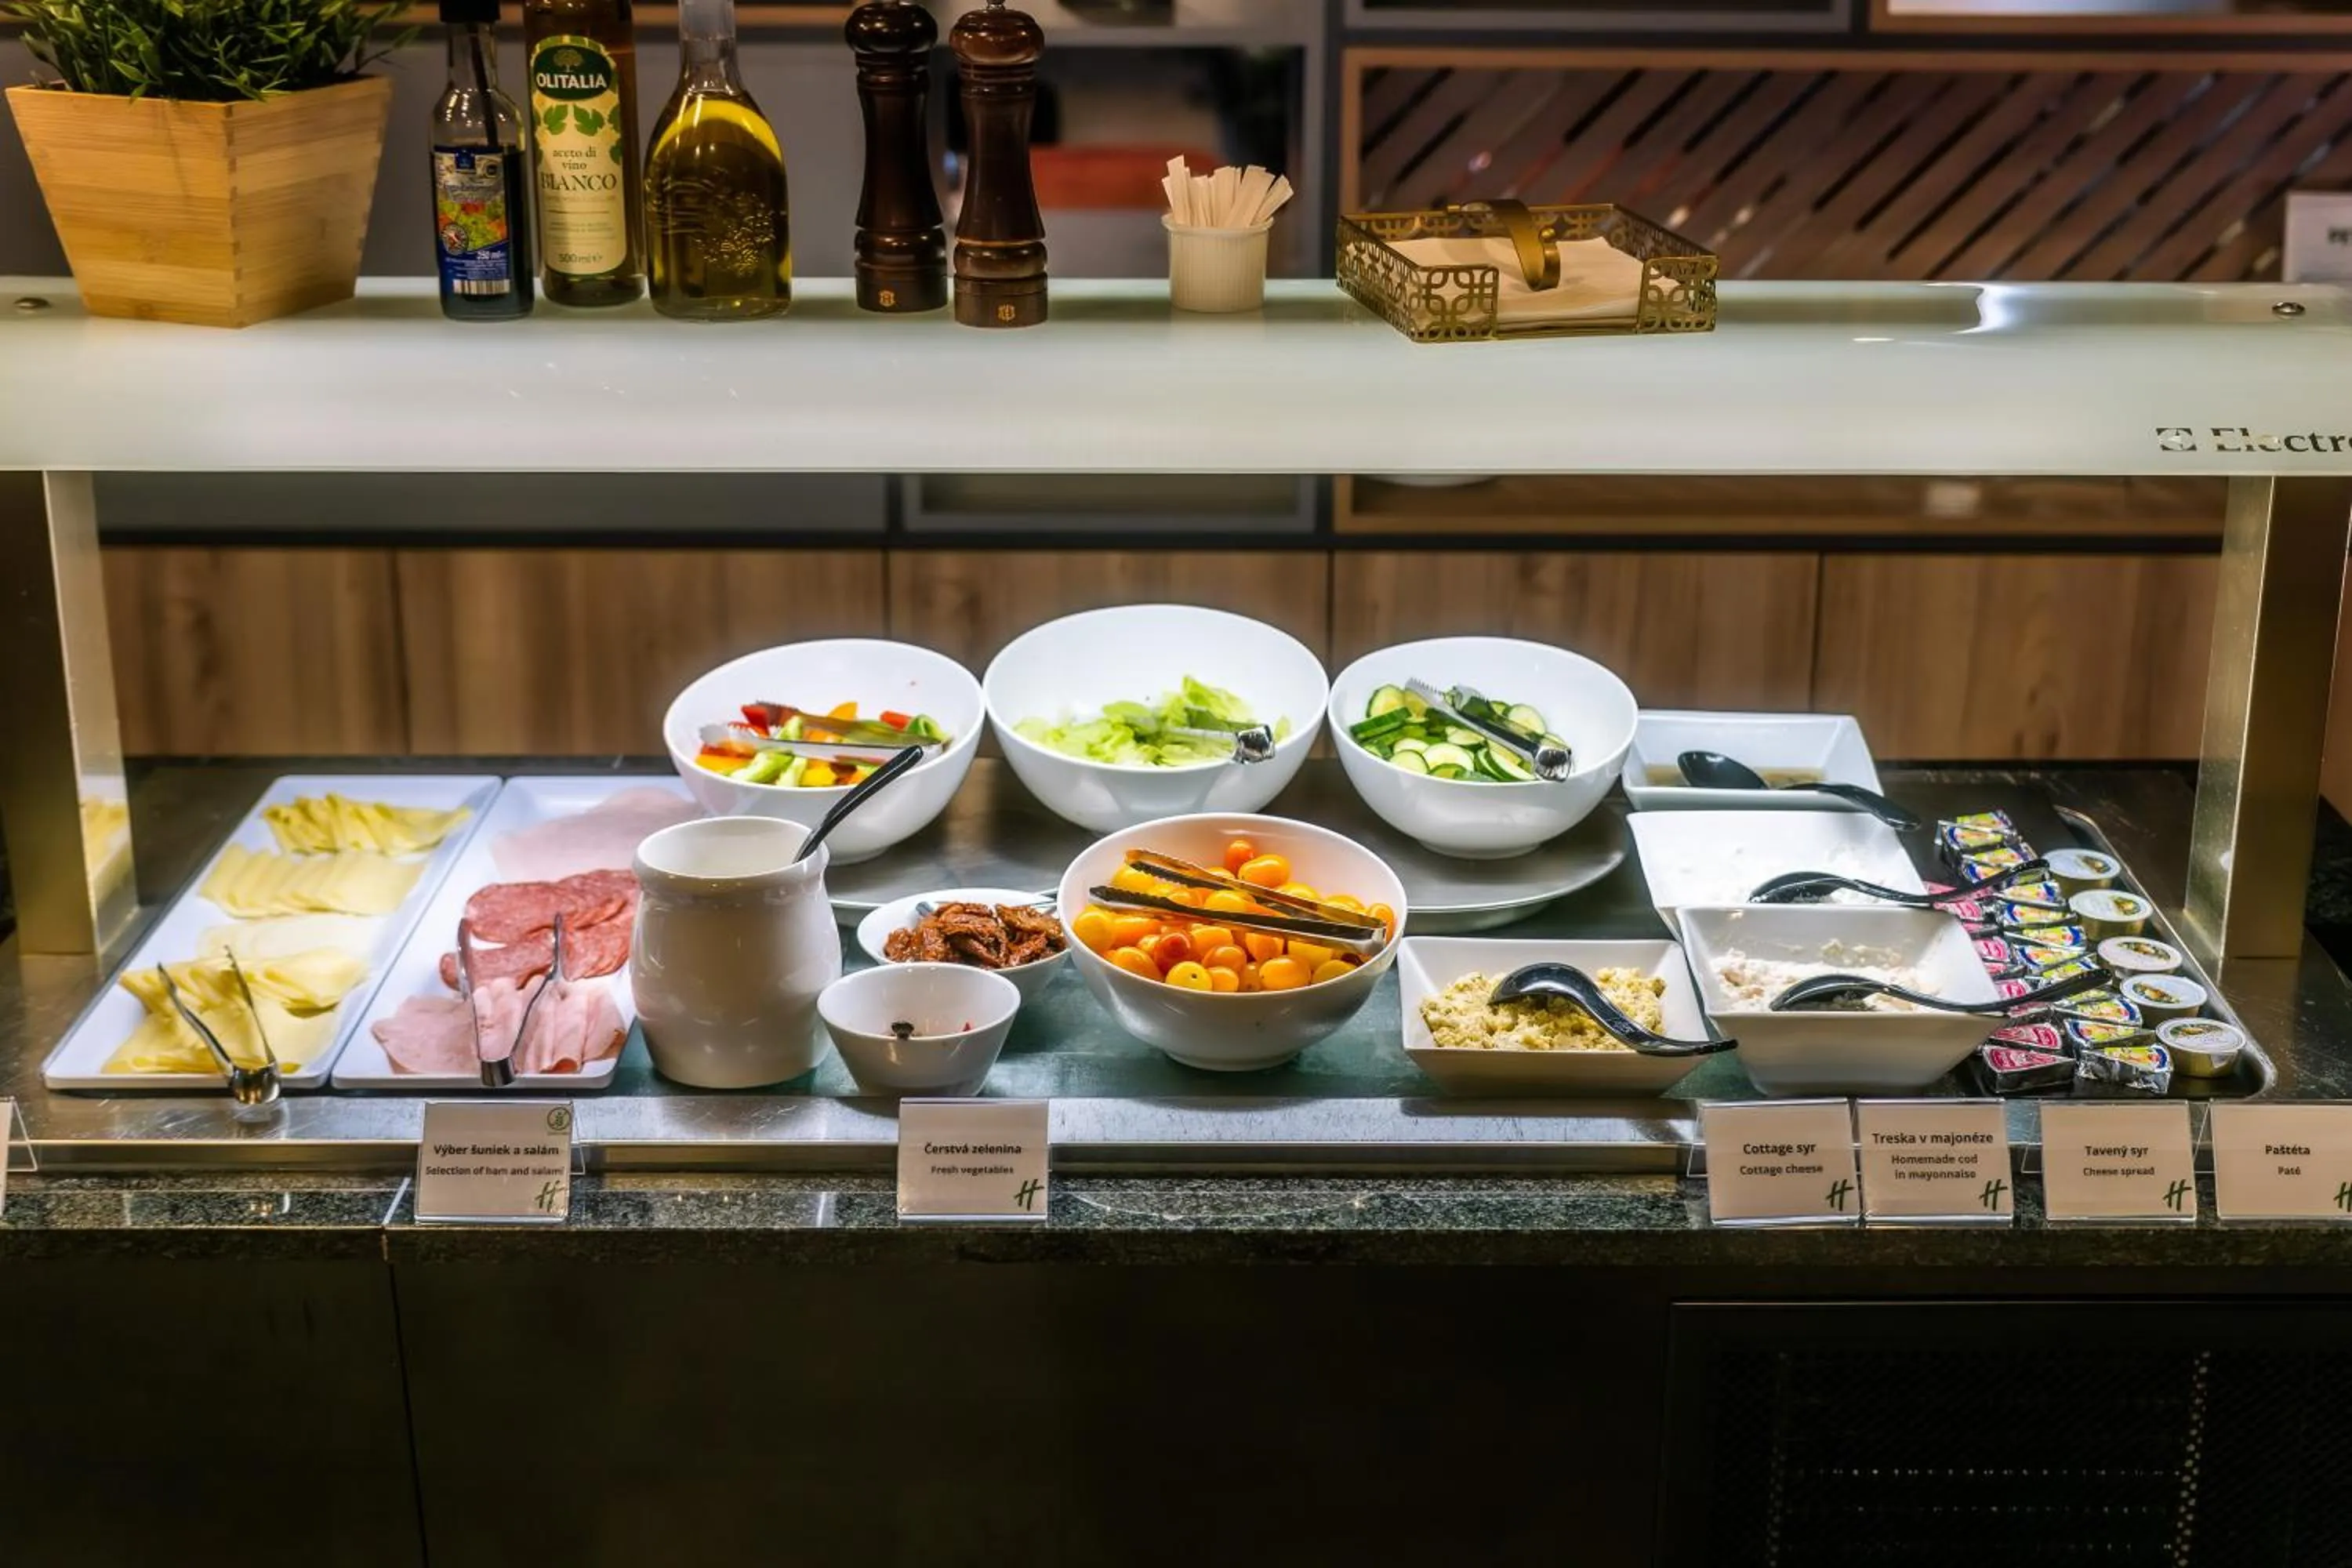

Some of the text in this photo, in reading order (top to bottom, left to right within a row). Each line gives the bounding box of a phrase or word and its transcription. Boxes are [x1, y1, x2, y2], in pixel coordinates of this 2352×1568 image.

[536, 72, 608, 89] OLITALIA
[553, 146, 597, 158] aceto di
[561, 159, 587, 170] vino
[2210, 427, 2352, 452] Electr
[1871, 1132, 1994, 1146] Treska v majonéze
[434, 1145, 468, 1157] Výber
[470, 1144, 510, 1155] šuniek
[523, 1145, 559, 1155] salám
[924, 1142, 1022, 1155] Čerstvá zelenina
[1743, 1143, 1817, 1156] Cottage syr
[2085, 1145, 2149, 1158] Tavený syr
[2265, 1144, 2310, 1155] Paštéta
[1891, 1154, 1978, 1164] Homemade cod
[426, 1166, 470, 1175] Selection
[473, 1166, 484, 1175] of
[485, 1166, 508, 1175] ham
[511, 1166, 529, 1175] and
[931, 1165, 1014, 1177] Fresh vegetables
[1740, 1163, 1824, 1176] Cottage cheese
[1894, 1169, 1976, 1181] in mayonnaise
[2083, 1167, 2155, 1178] Cheese spread
